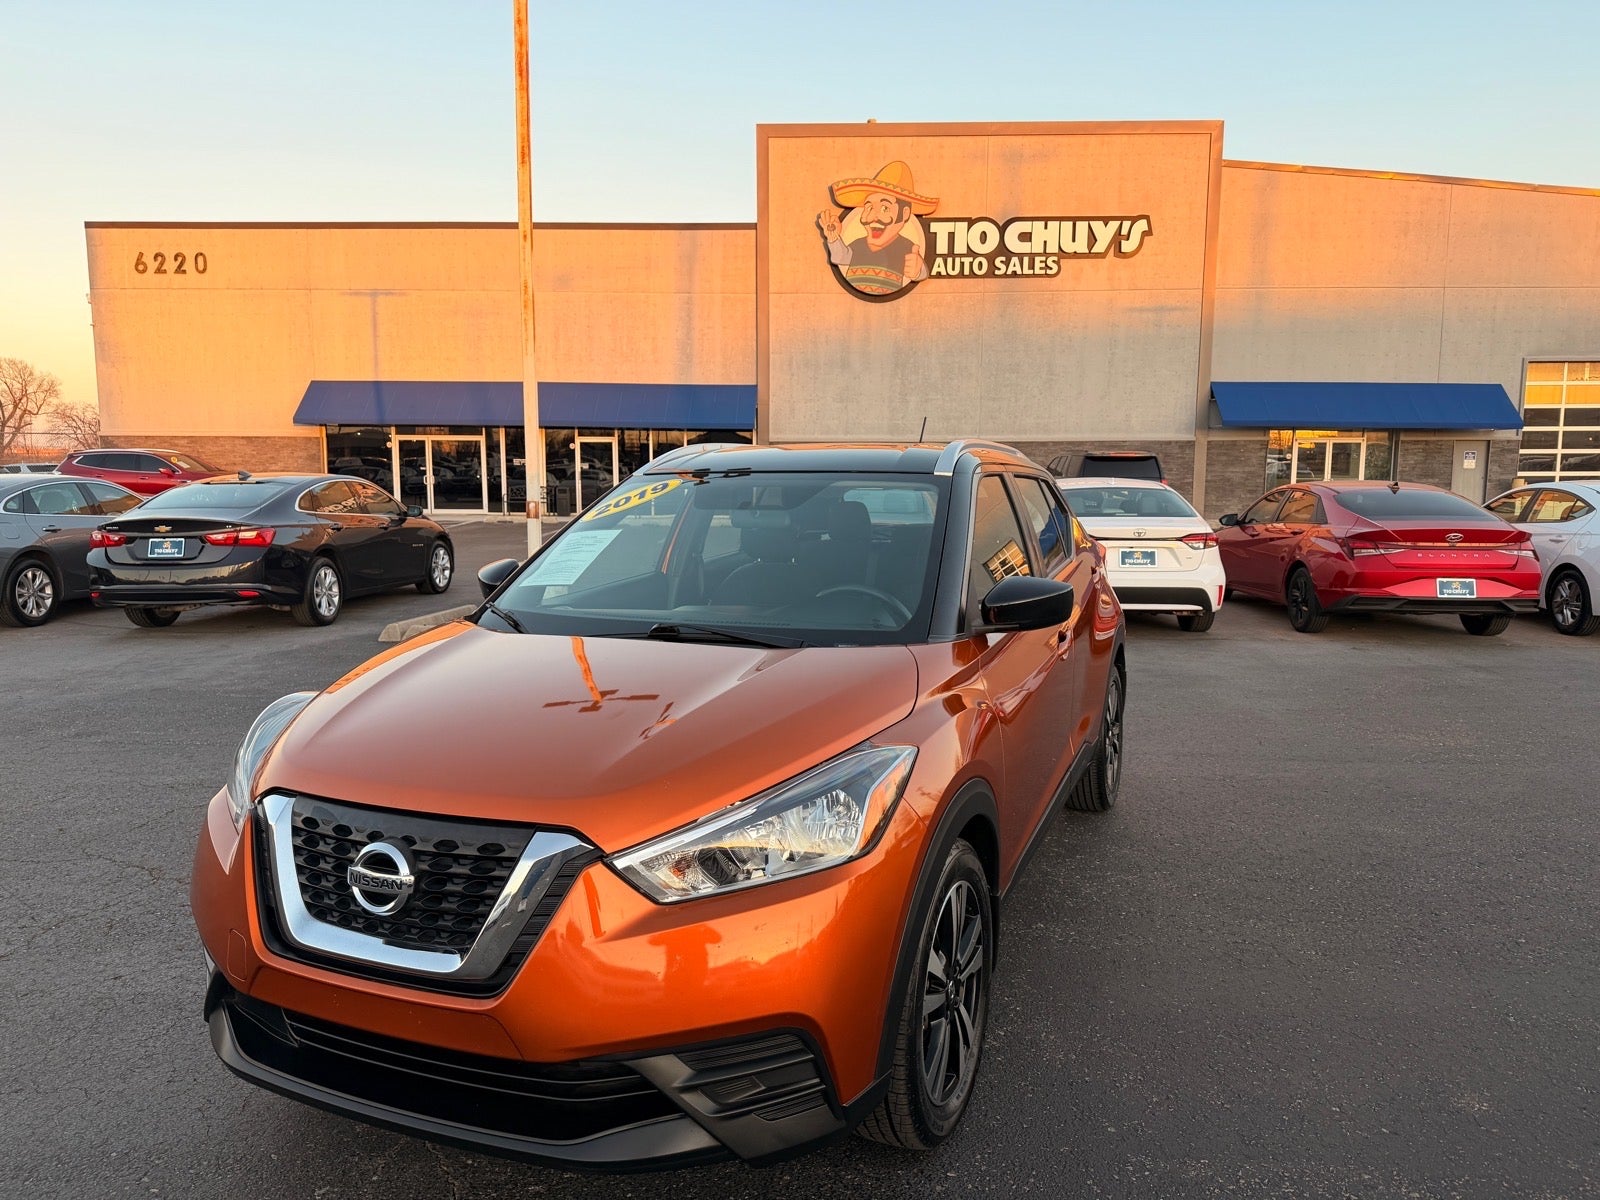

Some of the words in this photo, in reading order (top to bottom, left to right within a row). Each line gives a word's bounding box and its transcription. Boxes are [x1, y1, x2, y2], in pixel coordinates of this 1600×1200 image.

[930, 220, 1000, 254] TIO
[1003, 218, 1149, 254] CHUY'S
[134, 251, 208, 274] 6220
[929, 257, 989, 276] AUTO
[994, 256, 1059, 275] SALES
[592, 482, 669, 518] 2019
[350, 872, 403, 891] NISSAN
